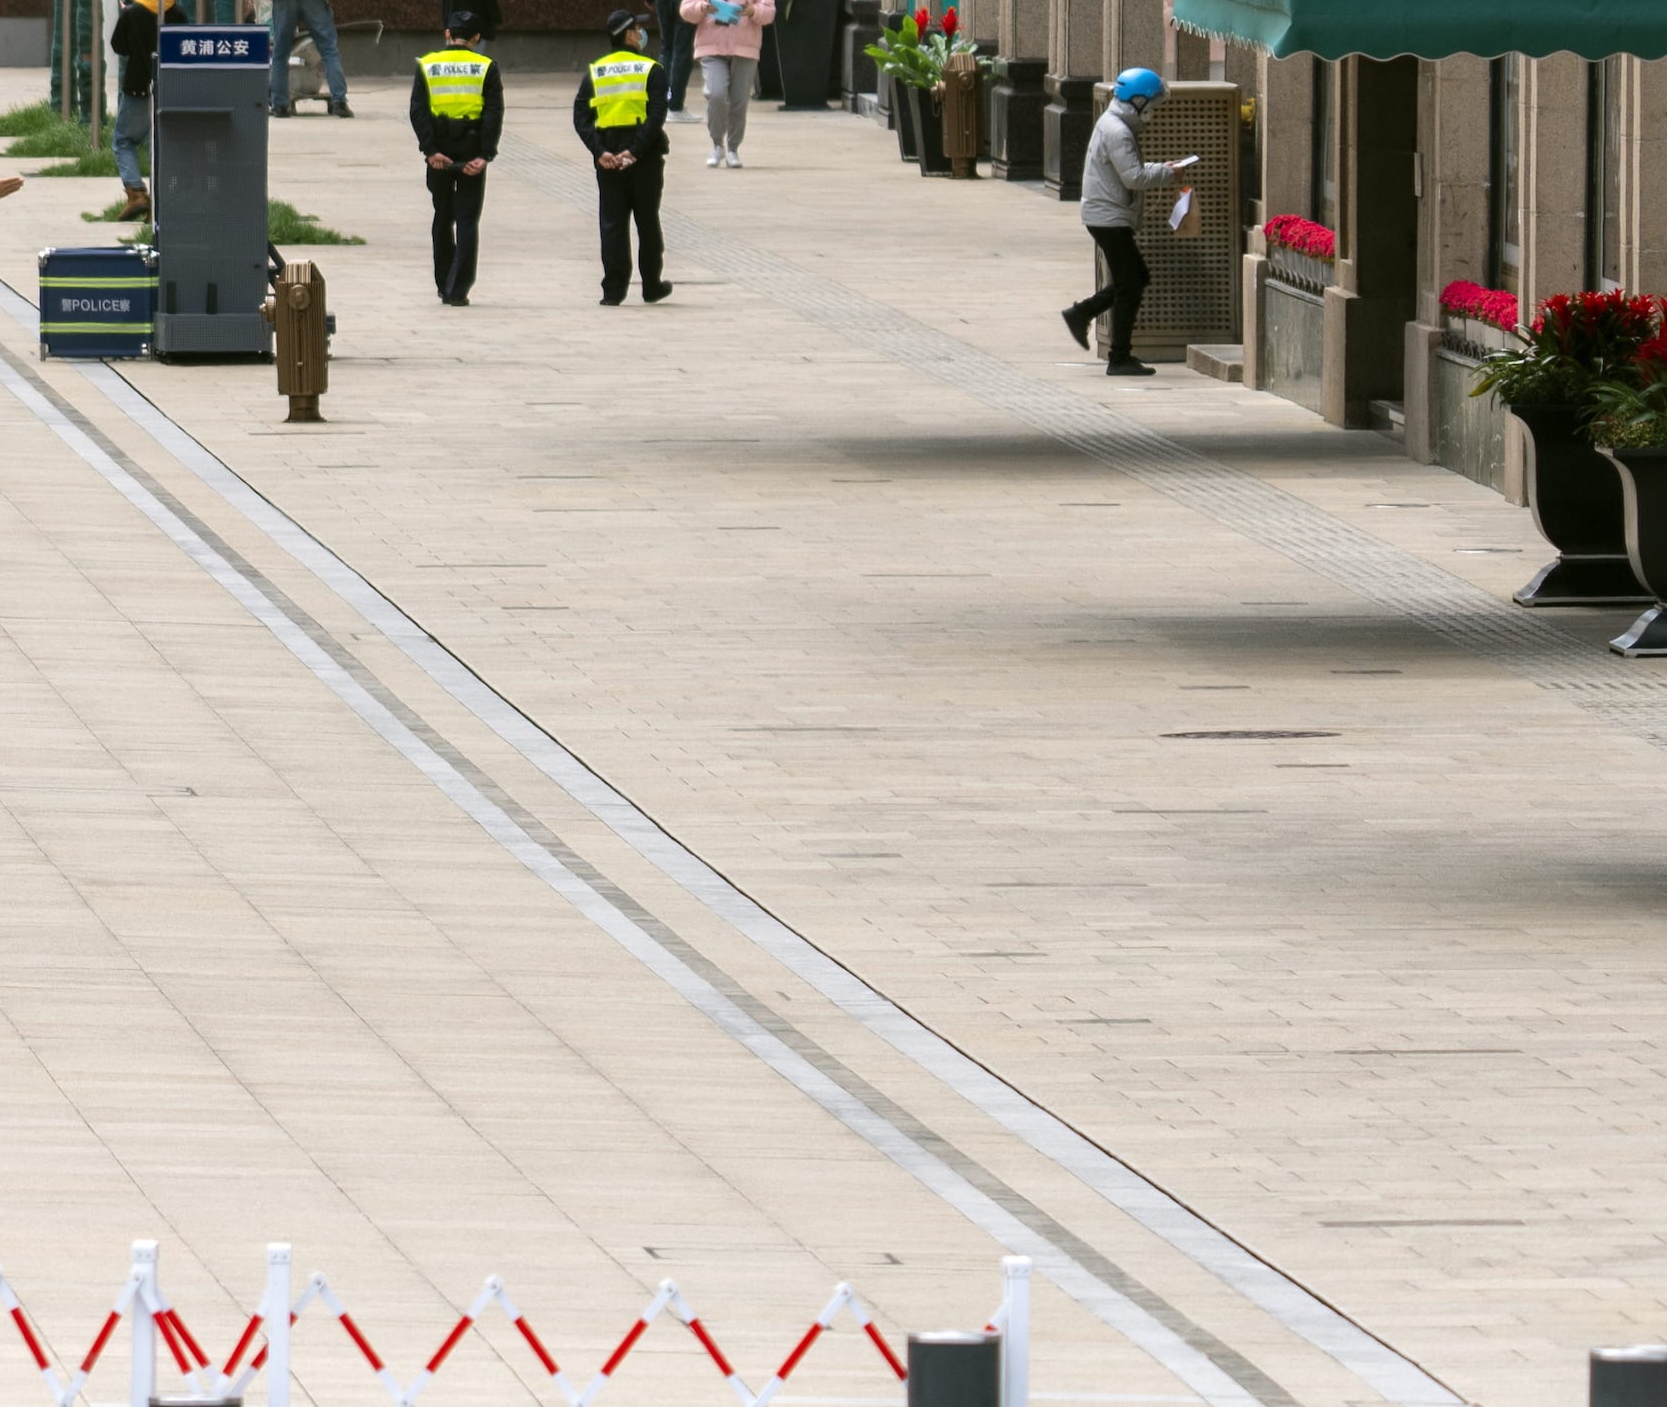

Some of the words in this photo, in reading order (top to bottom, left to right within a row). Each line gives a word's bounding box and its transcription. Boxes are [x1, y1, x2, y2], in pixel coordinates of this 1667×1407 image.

[181, 39, 250, 56] 黄浦公安
[443, 65, 468, 75] POLICE
[608, 64, 632, 74] POLICE
